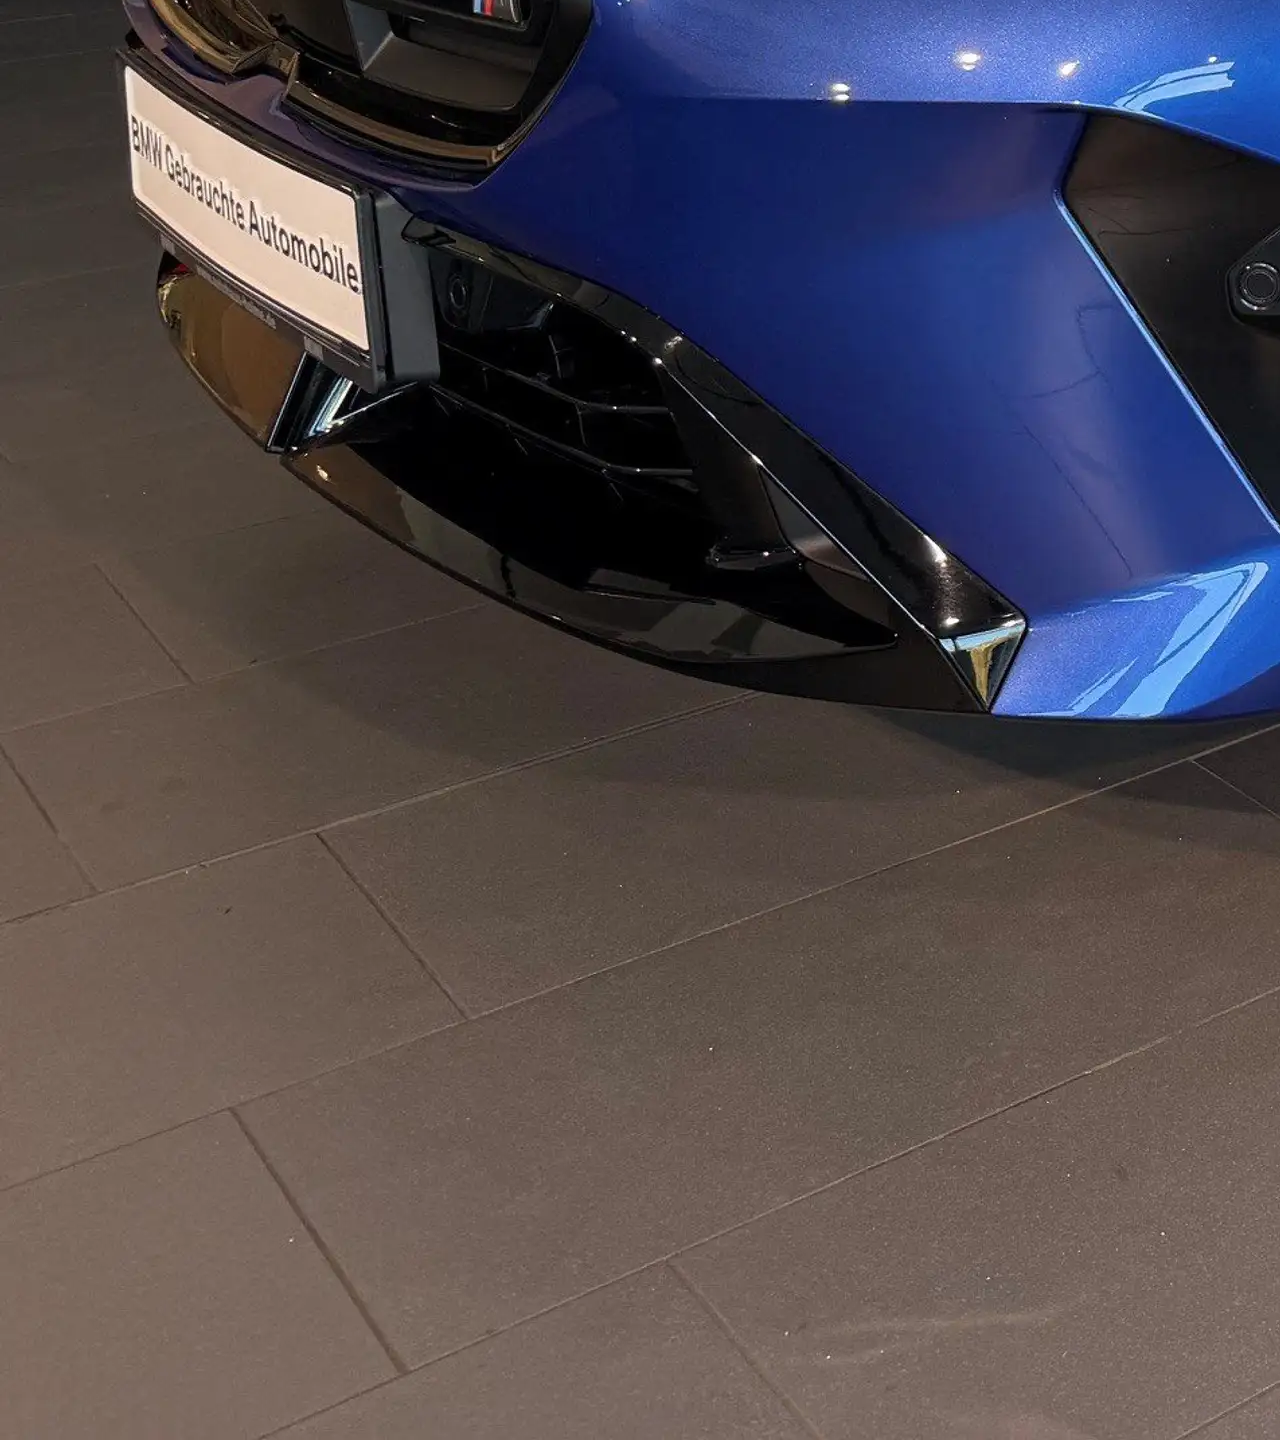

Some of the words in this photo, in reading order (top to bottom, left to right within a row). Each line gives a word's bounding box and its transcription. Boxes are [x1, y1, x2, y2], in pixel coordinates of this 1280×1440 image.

[131, 114, 163, 172] BMW
[165, 144, 246, 232] Gebrauchte
[249, 200, 361, 294] Automobile
